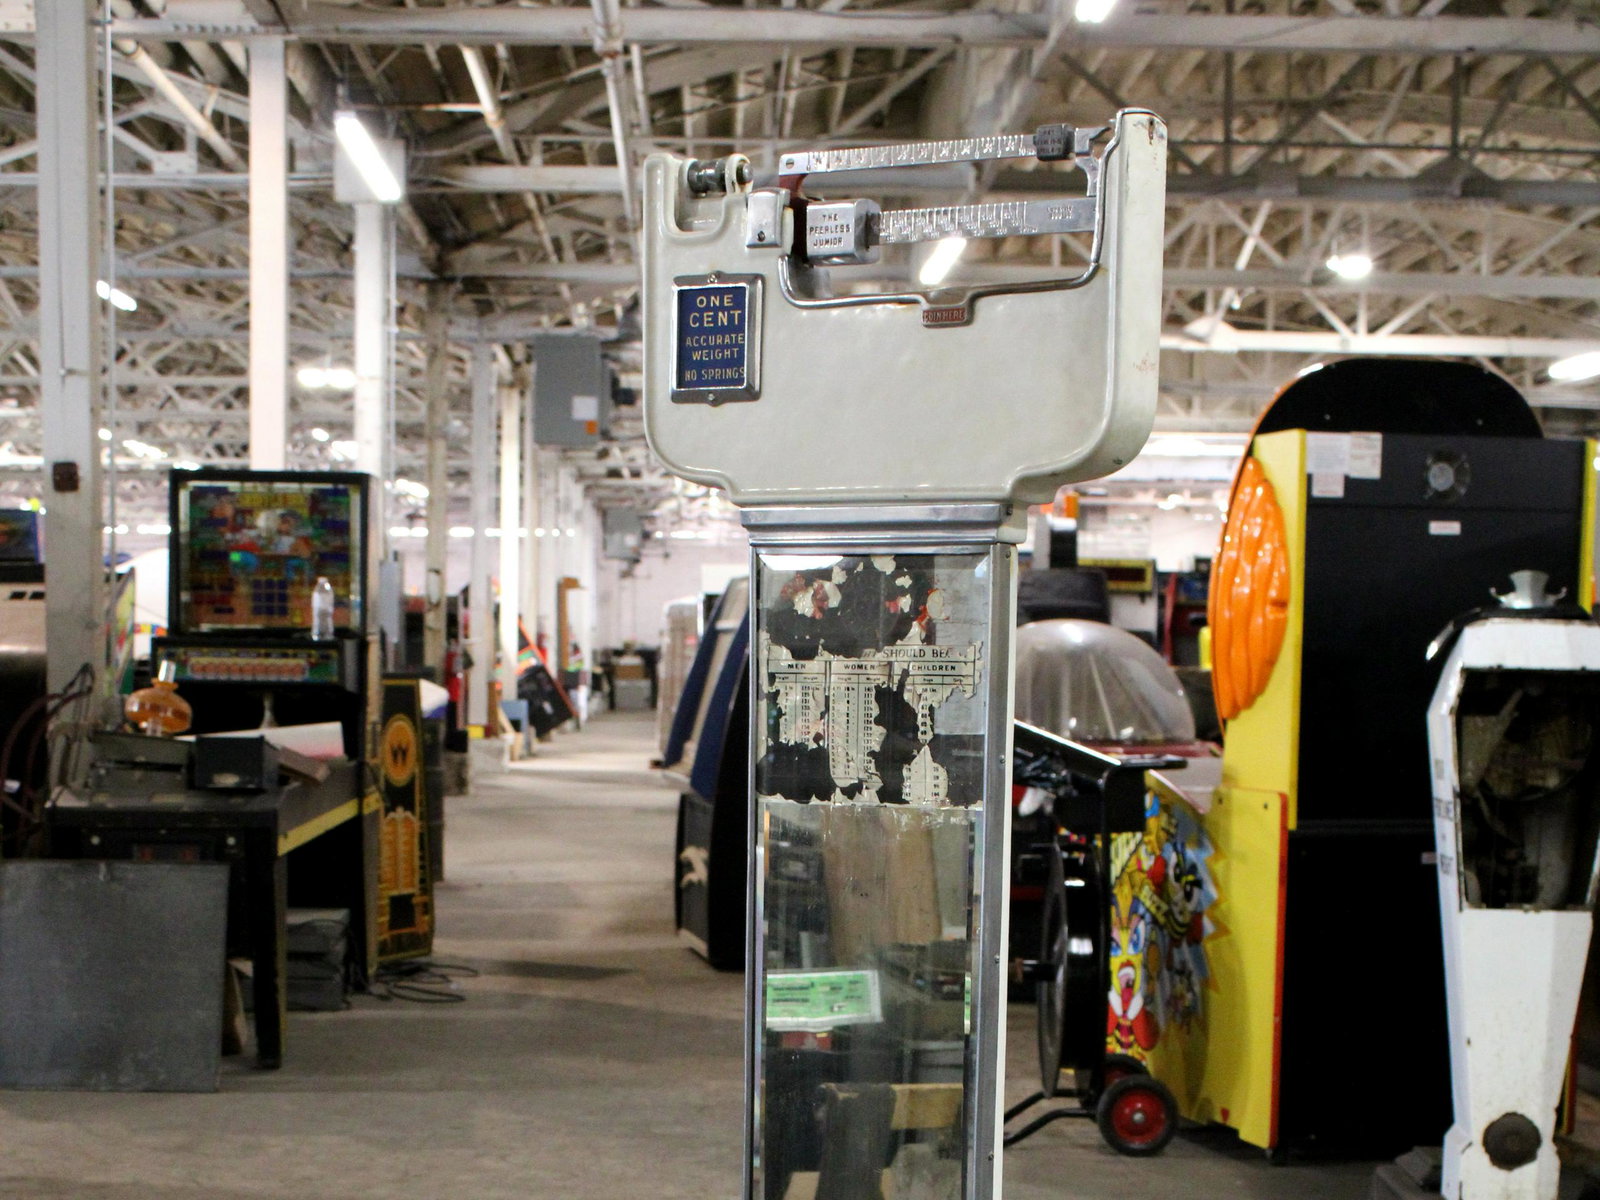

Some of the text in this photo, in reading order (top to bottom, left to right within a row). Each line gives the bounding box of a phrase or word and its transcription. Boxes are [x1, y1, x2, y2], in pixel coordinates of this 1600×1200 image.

[822, 213, 838, 221] THE
[809, 224, 850, 235] PEERLESS
[813, 237, 843, 247] JUNIOR
[696, 294, 733, 308] ONE
[689, 310, 742, 328] CENT
[923, 310, 965, 321] COIN HERE
[685, 333, 745, 347] ACCURATE
[692, 348, 739, 361] WEIGHT
[684, 367, 746, 381] NO SPRINGS
[883, 645, 926, 658] SHOULD
